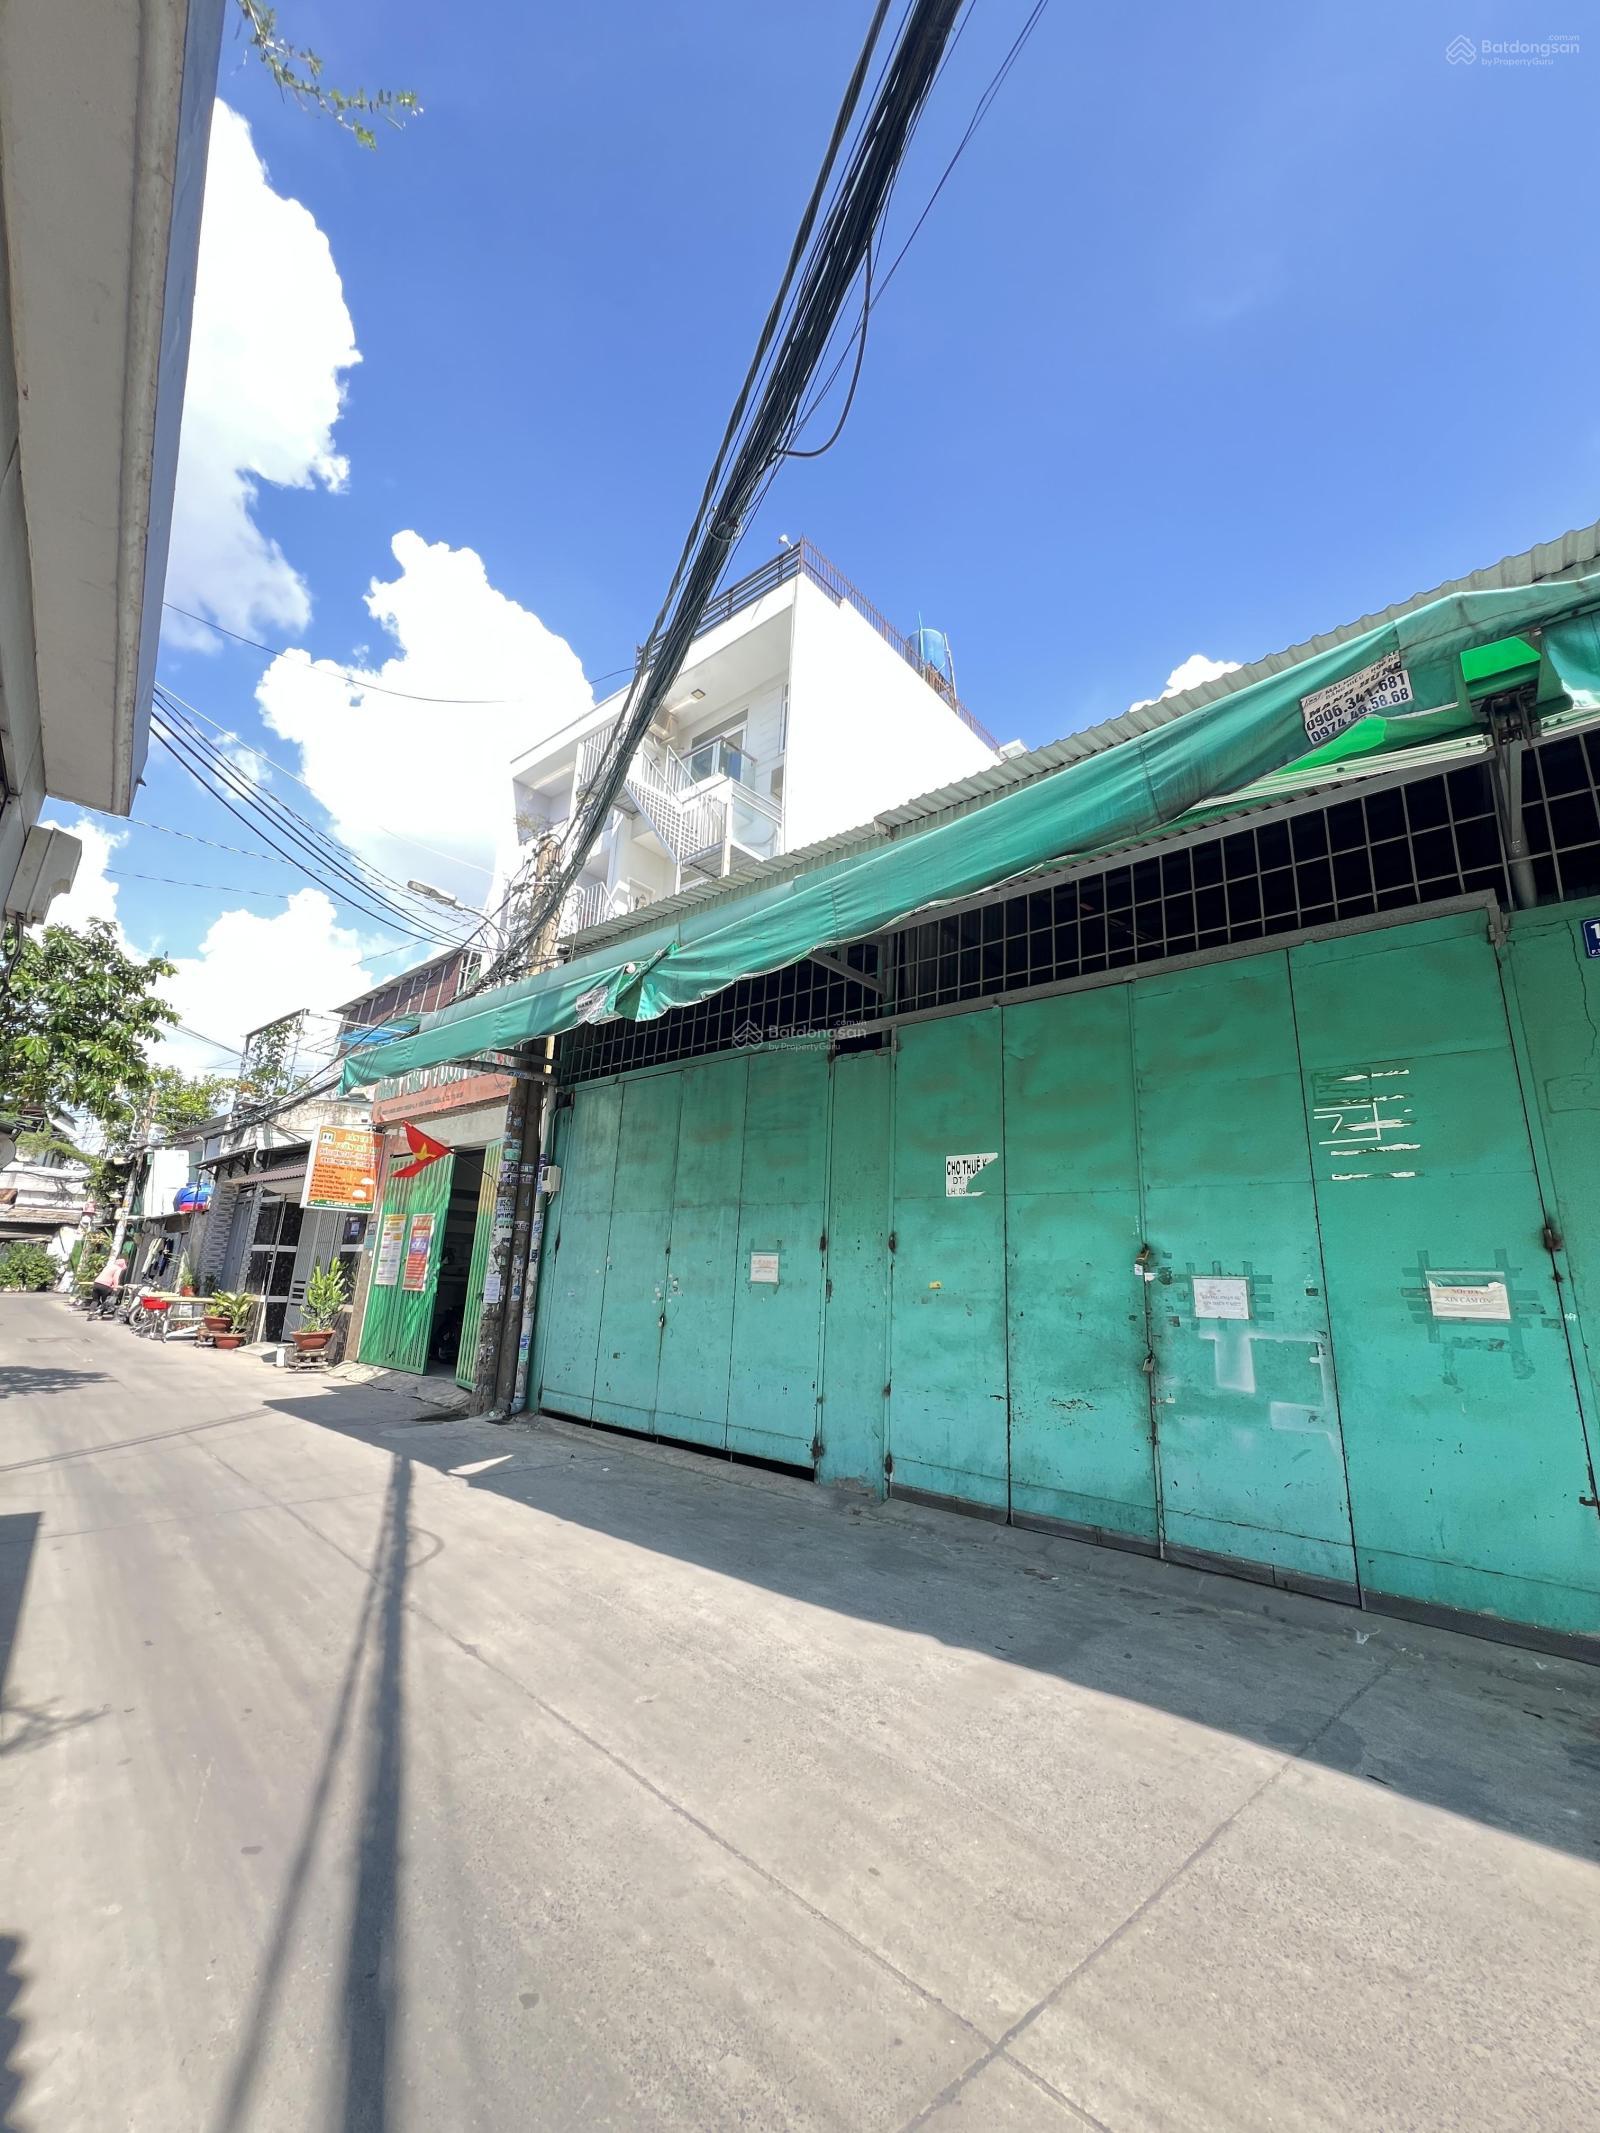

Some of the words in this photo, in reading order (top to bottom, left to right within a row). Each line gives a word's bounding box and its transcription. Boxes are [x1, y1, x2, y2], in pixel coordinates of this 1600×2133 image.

[1306, 672, 1406, 731] 0906.341.681
[1310, 687, 1410, 743] 0974.46.58.68
[947, 1160, 961, 1176] CHO
